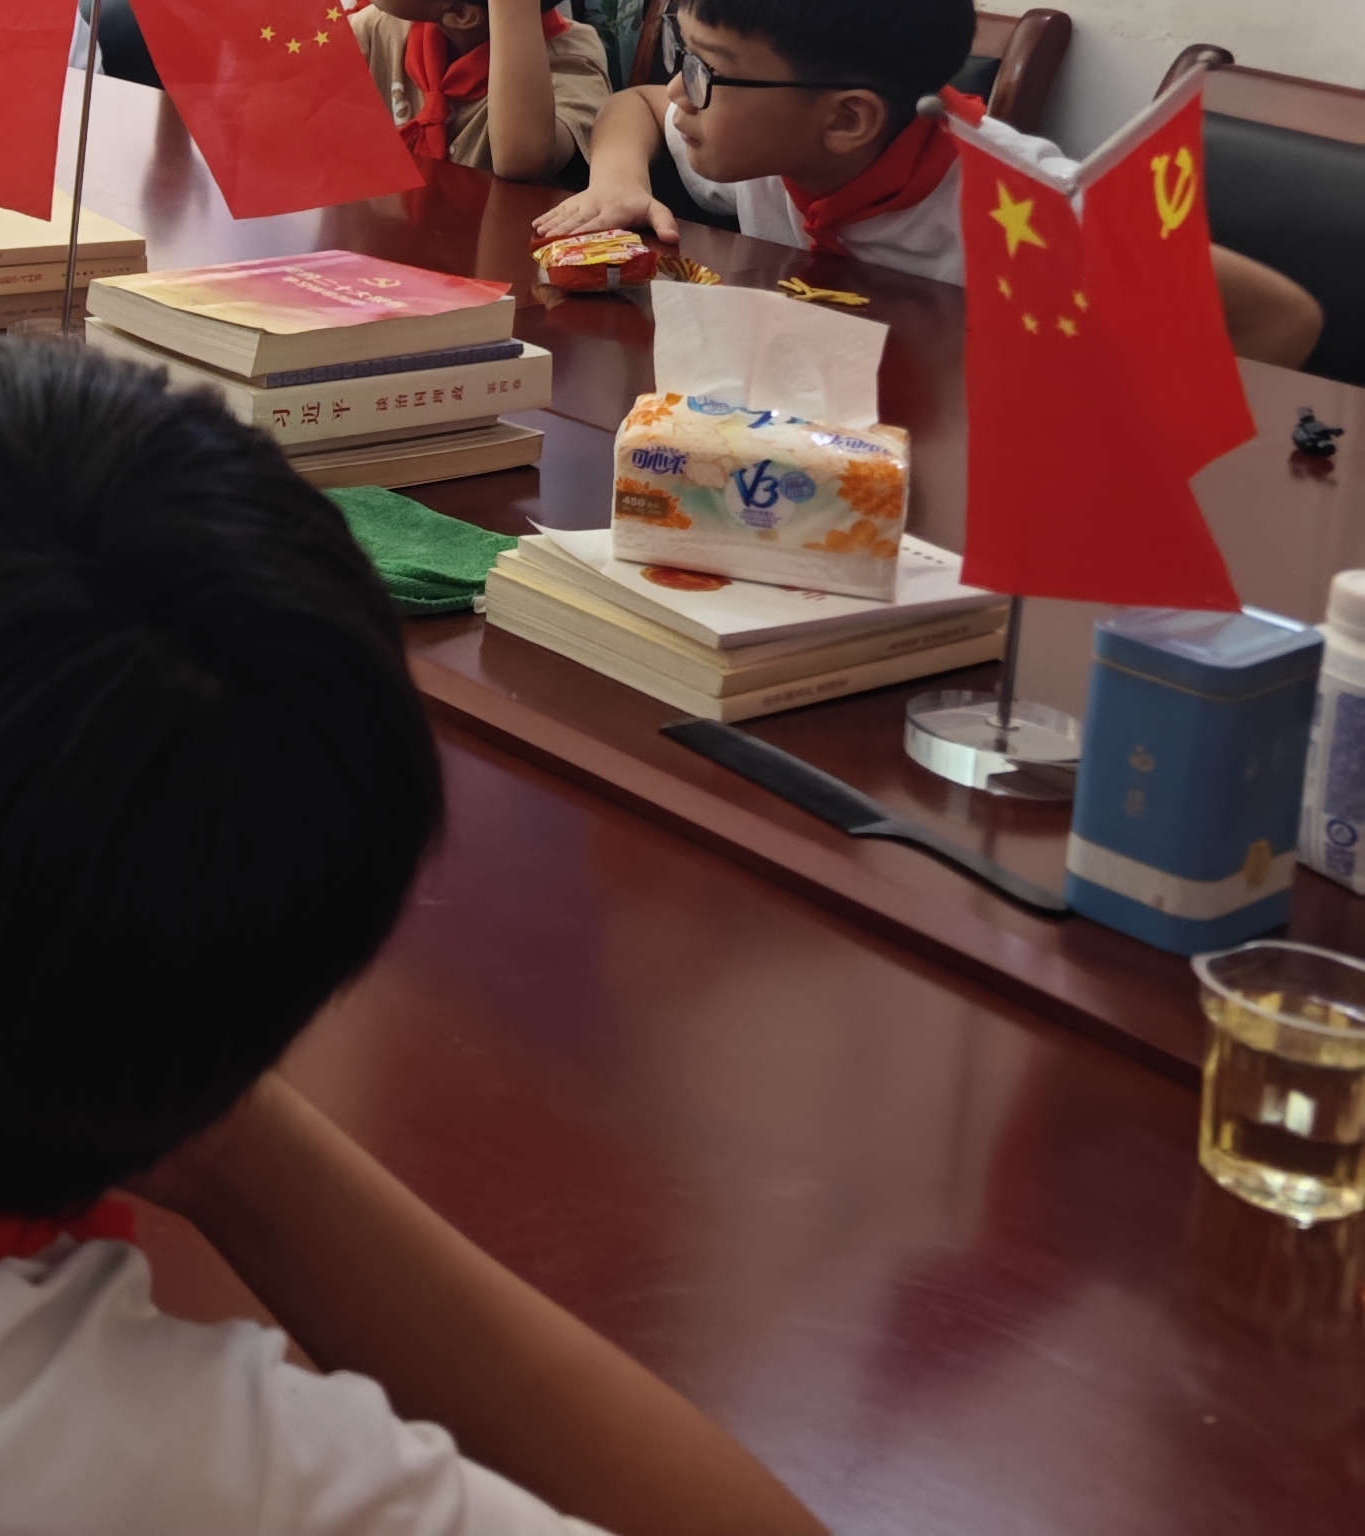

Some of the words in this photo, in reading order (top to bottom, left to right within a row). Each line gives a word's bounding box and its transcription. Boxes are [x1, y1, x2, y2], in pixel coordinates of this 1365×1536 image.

[272, 398, 351, 428] 习近平
[375, 385, 464, 412] 谈治国理政
[487, 379, 522, 394] 第四卷
